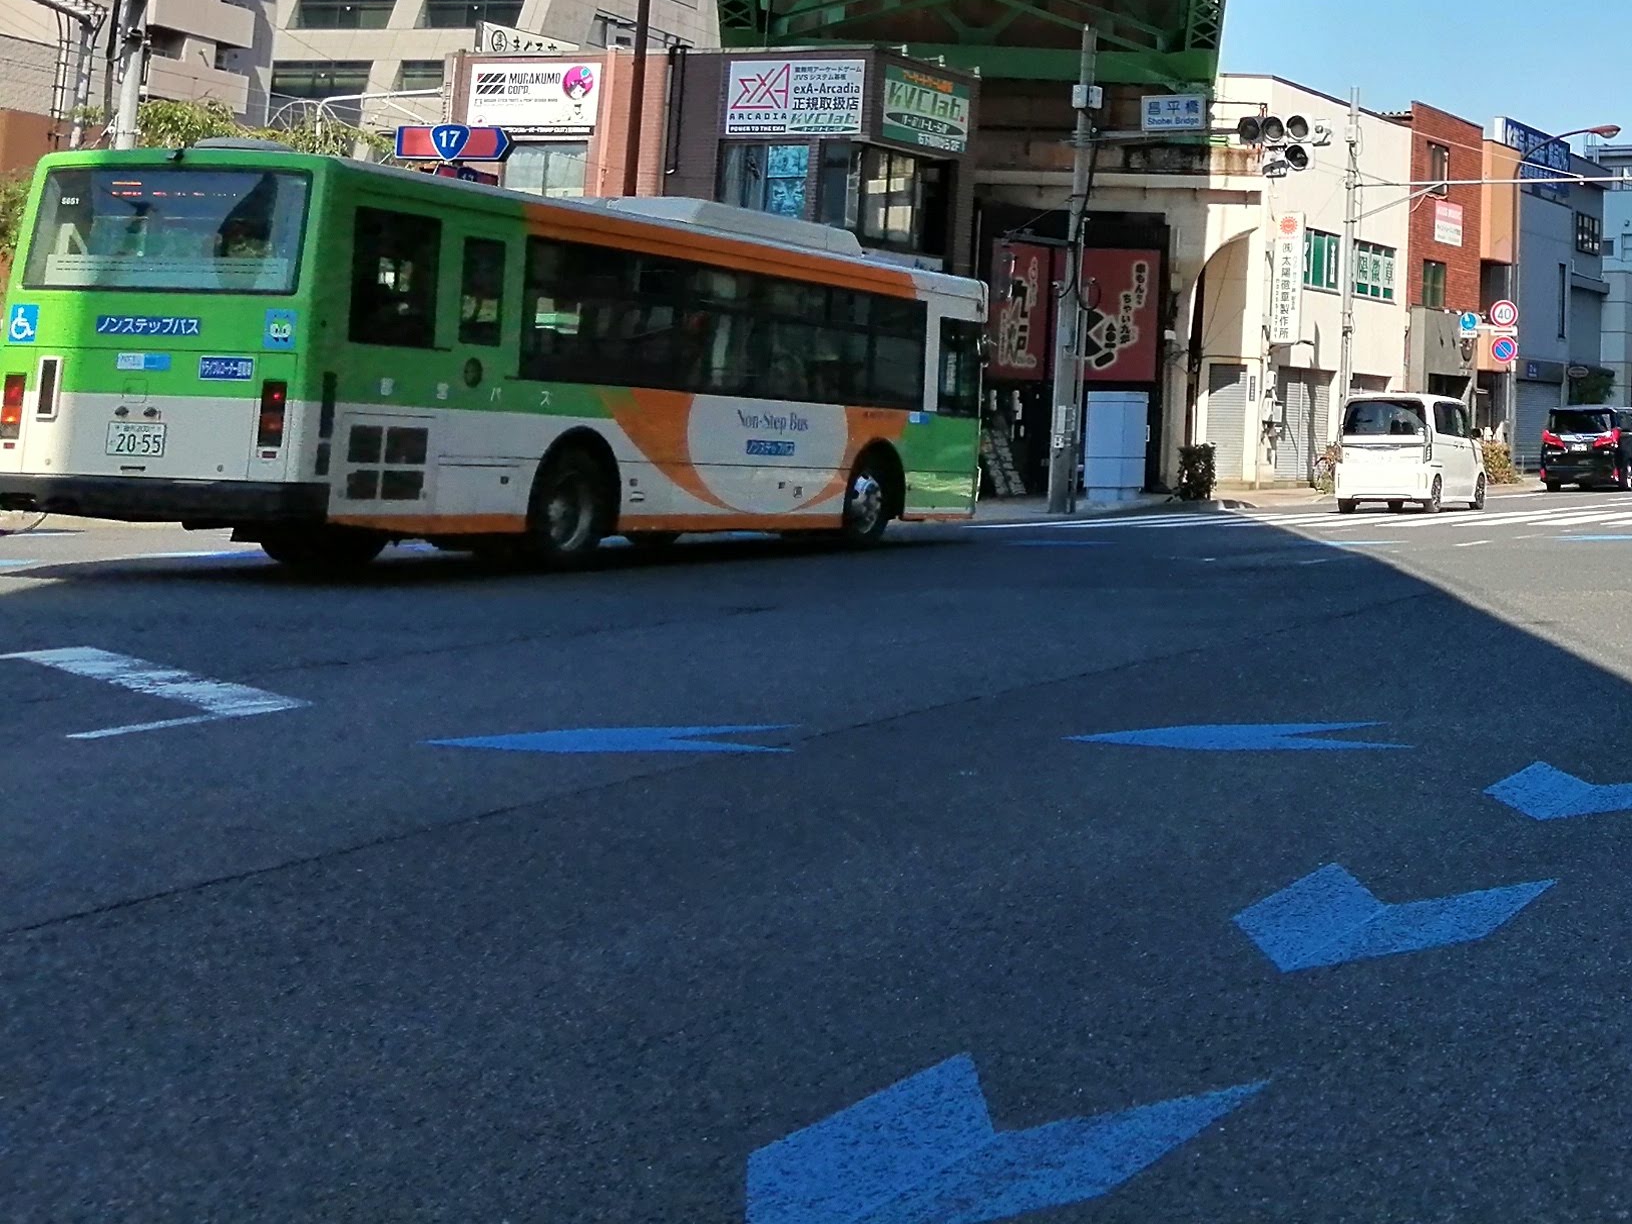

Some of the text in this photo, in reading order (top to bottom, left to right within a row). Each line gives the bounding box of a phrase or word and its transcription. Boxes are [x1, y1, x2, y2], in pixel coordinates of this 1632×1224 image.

[793, 82, 861, 94] exA-Arcadia
[792, 96, 860, 111] 正規取扱店
[1148, 100, 1200, 116] 昌平橋
[729, 112, 787, 121] ARCADIA
[1147, 117, 1200, 126] Shohei Bridge
[438, 131, 461, 149] 17
[1497, 308, 1511, 320] 40
[97, 317, 199, 335] ノンステップバス
[115, 433, 162, 454] 20-55
